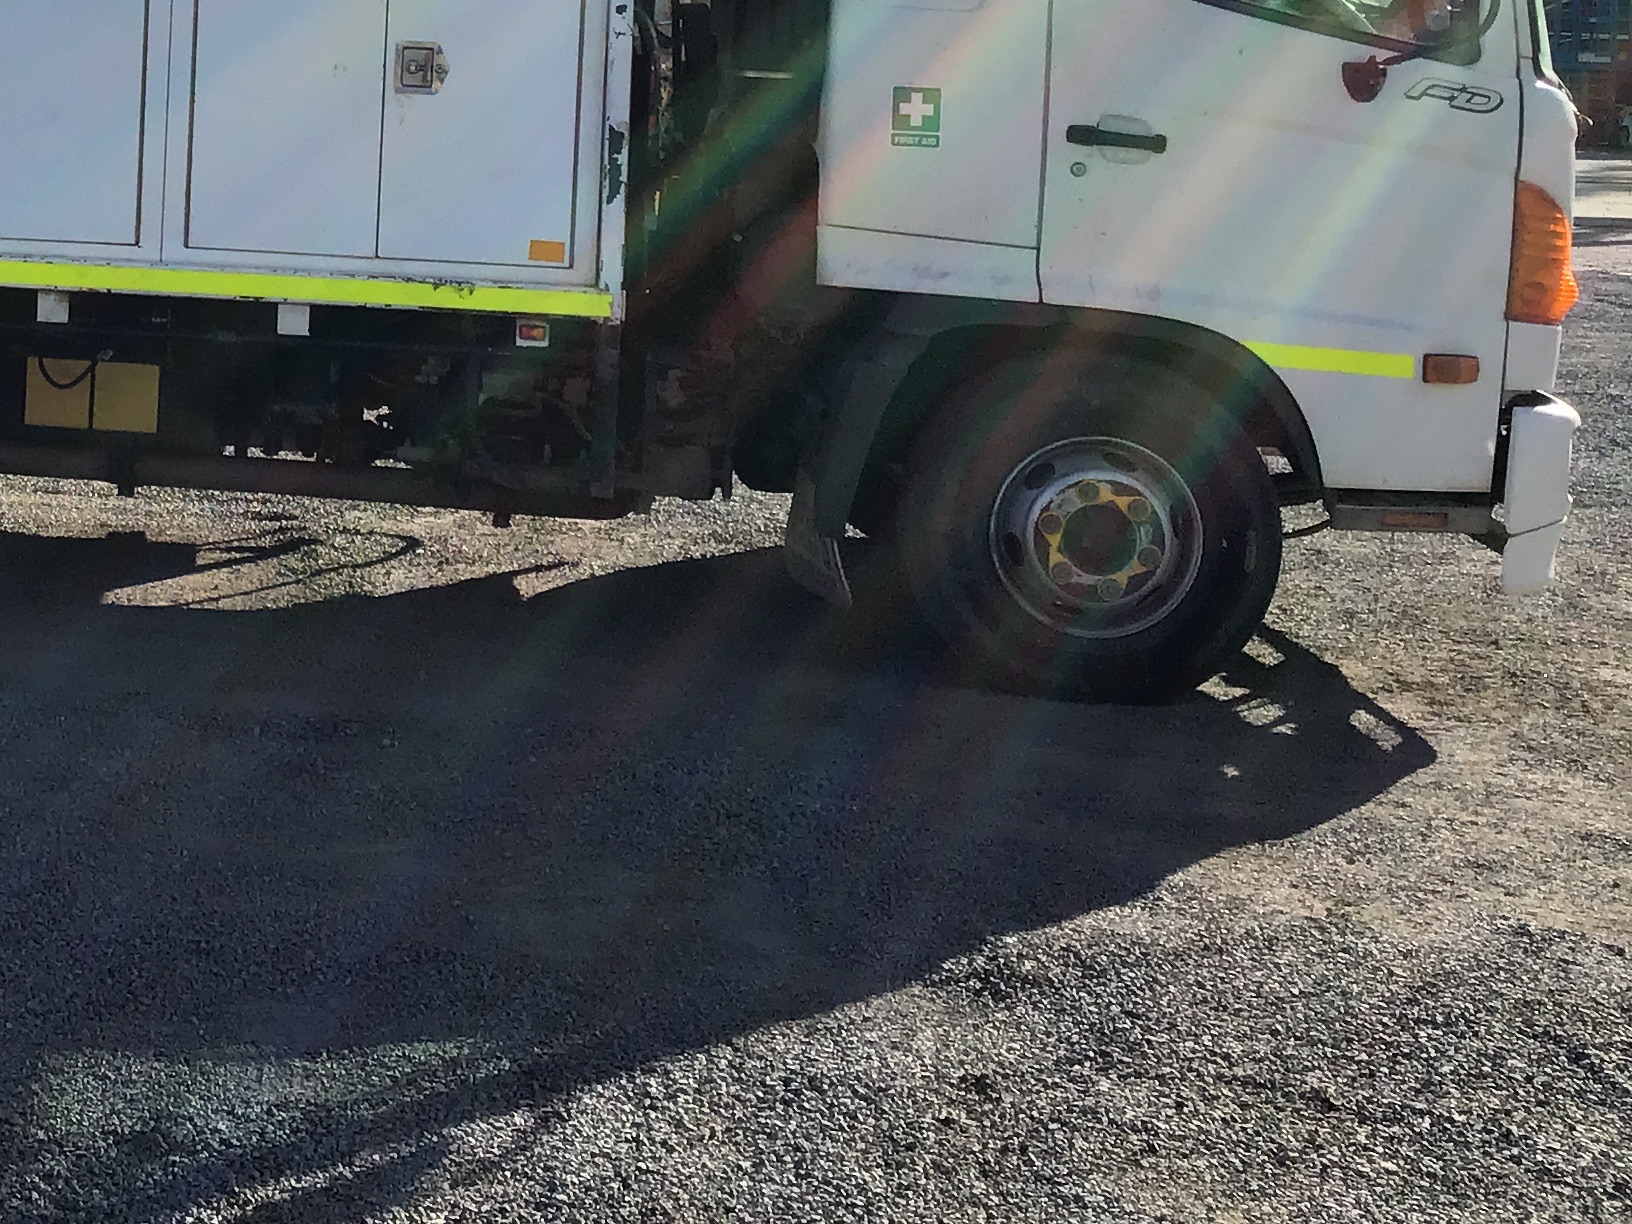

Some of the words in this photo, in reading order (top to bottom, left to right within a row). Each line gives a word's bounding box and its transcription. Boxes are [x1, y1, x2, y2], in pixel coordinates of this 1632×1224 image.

[1404, 77, 1504, 113] FD
[894, 136, 919, 145] FIRST
[921, 137, 937, 146] AID
